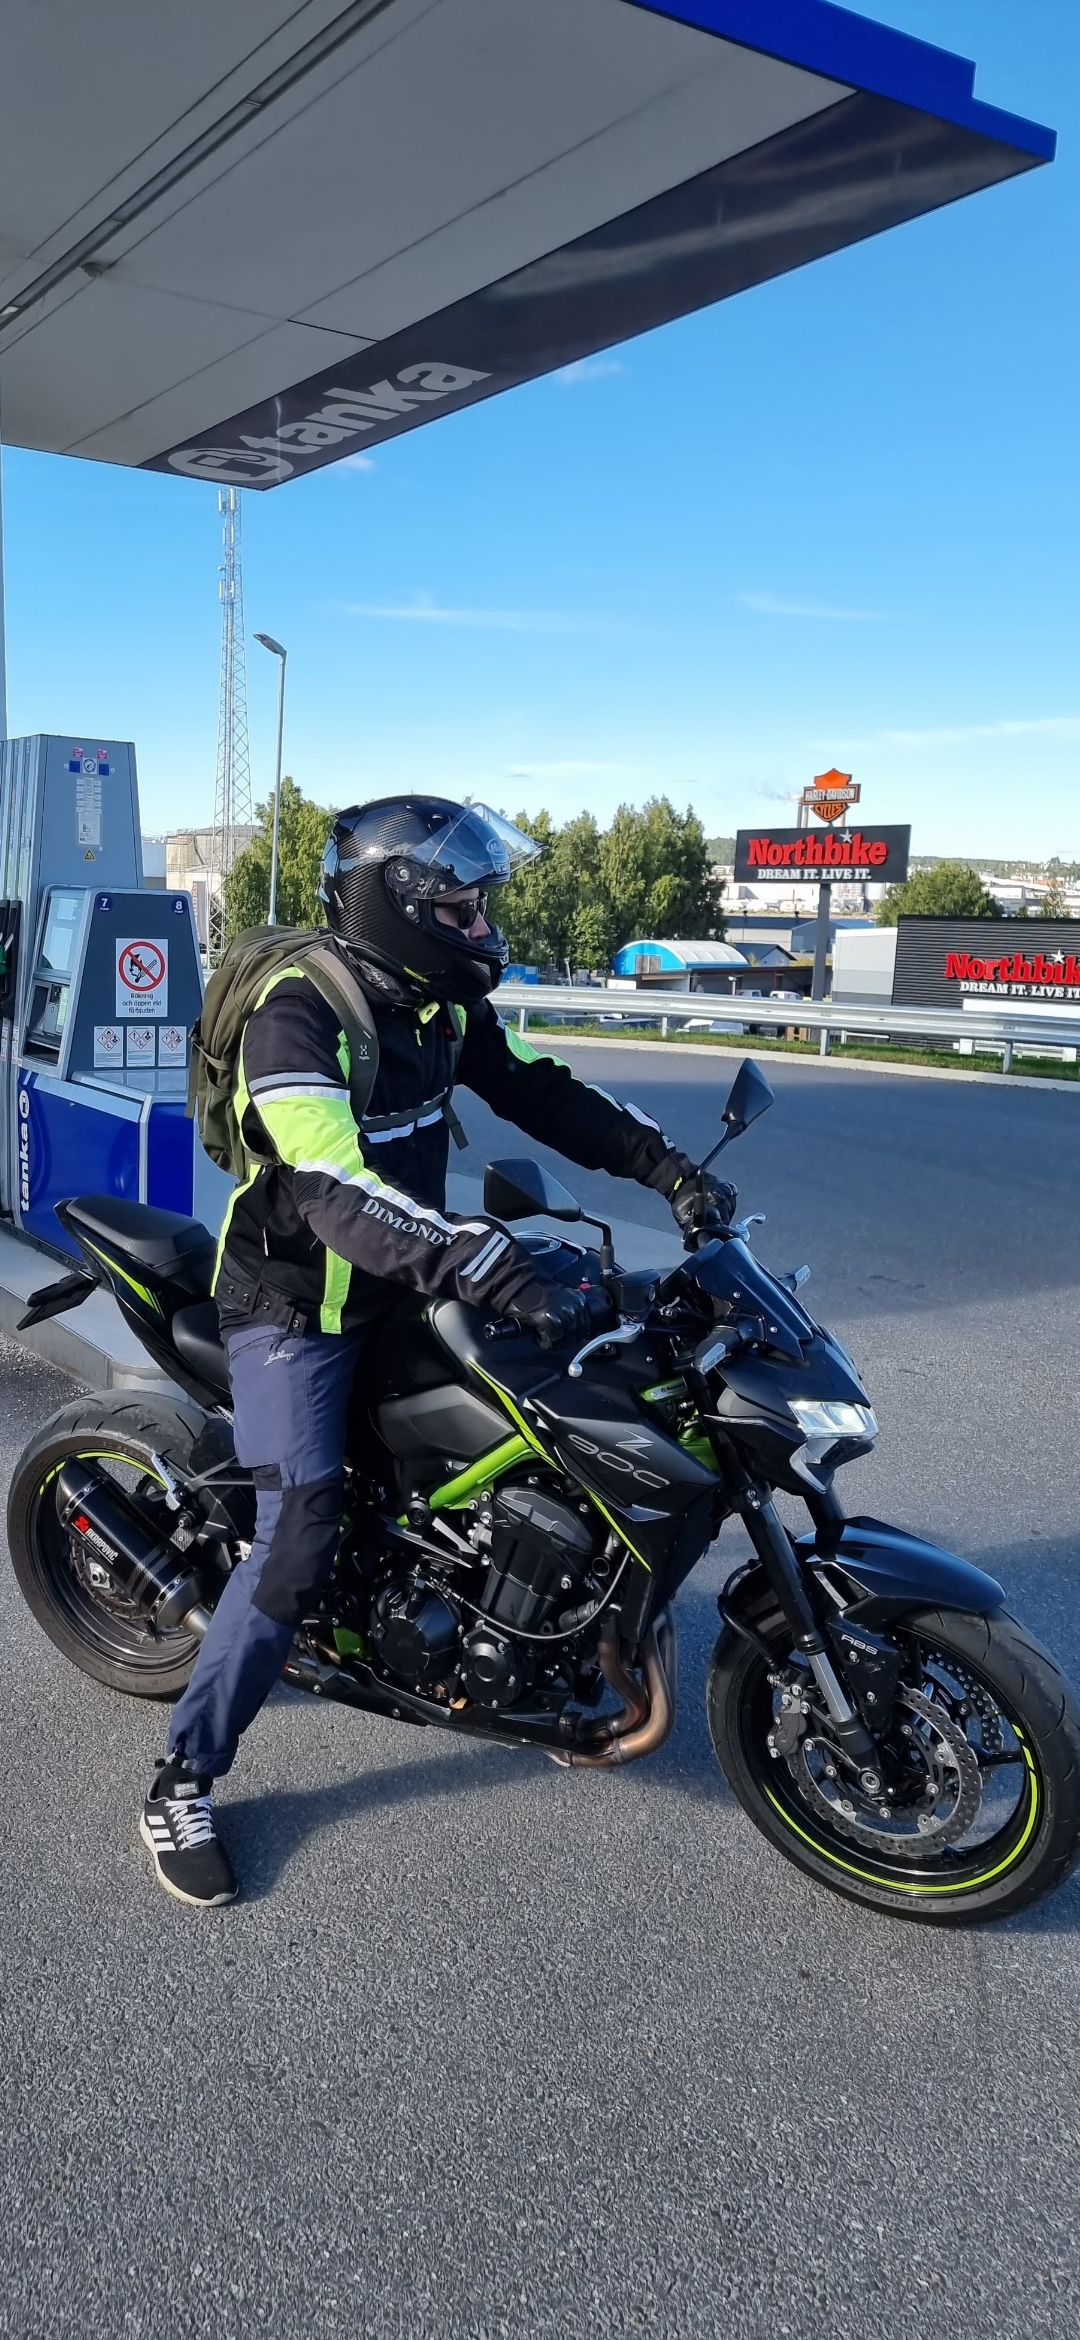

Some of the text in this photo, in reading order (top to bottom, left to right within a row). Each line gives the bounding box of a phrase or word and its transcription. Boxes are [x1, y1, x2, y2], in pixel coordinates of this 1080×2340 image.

[239, 362, 493, 454] tanka
[814, 803, 843, 818] CYCLES
[747, 831, 887, 866] Northbike
[757, 867, 872, 880] DREAM IT. LIVE IT.
[101, 898, 108, 907] 7
[175, 900, 183, 910] 8
[960, 982, 1009, 994] DREAM
[1011, 984, 1028, 996] IT.
[1031, 985, 1064, 998] LIVE
[133, 1000, 152, 1008] öppen
[20, 1122, 30, 1212] tanka
[361, 1199, 458, 1246] DIMONDY
[568, 1434, 671, 1489] 900
[841, 1634, 878, 1655] ABS
